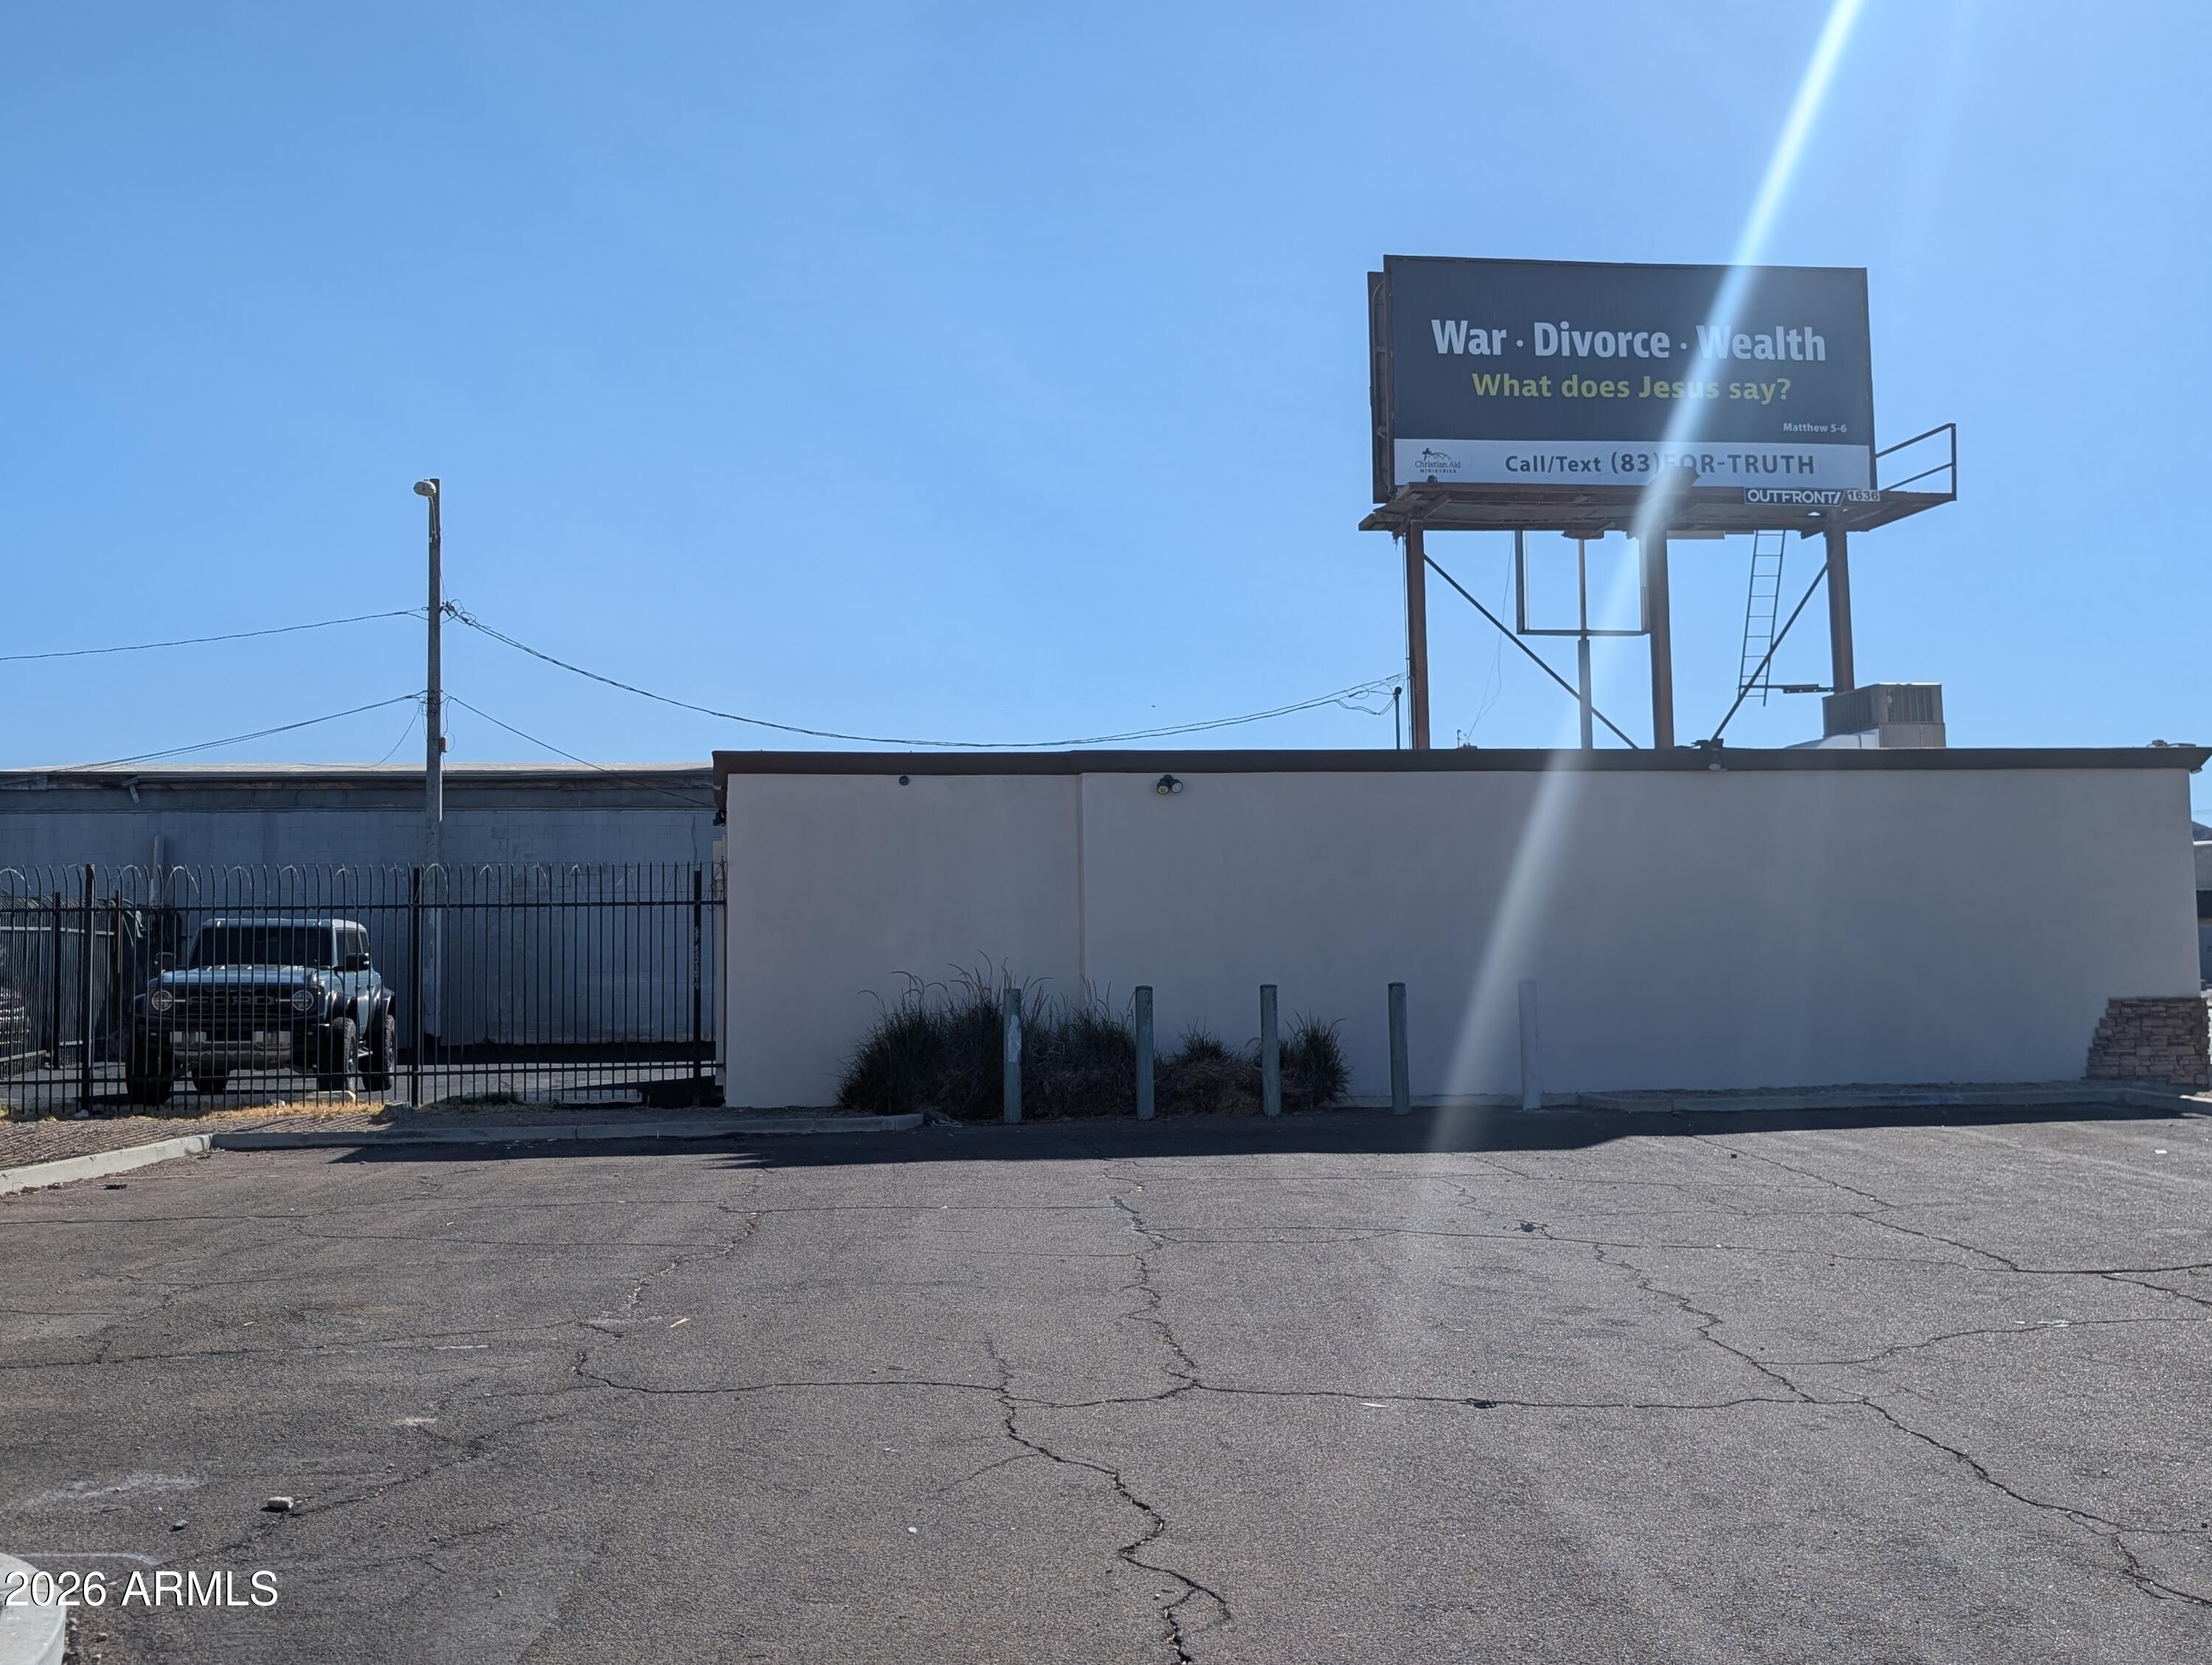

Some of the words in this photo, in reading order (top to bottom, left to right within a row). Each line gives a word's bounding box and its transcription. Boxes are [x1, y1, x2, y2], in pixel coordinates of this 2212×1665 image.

[1431, 319, 1507, 355] War
[1534, 321, 1670, 358] Divorce
[1696, 325, 1826, 361] Wealth
[1472, 373, 1551, 397] What
[1561, 375, 1630, 398] does
[1638, 376, 1719, 400] Jesus
[1729, 378, 1791, 405] say?
[1783, 423, 1828, 432] Matthew
[1830, 423, 1847, 433] 5-6
[1505, 455, 1601, 473] Call/Text
[1848, 490, 1879, 501] 1636
